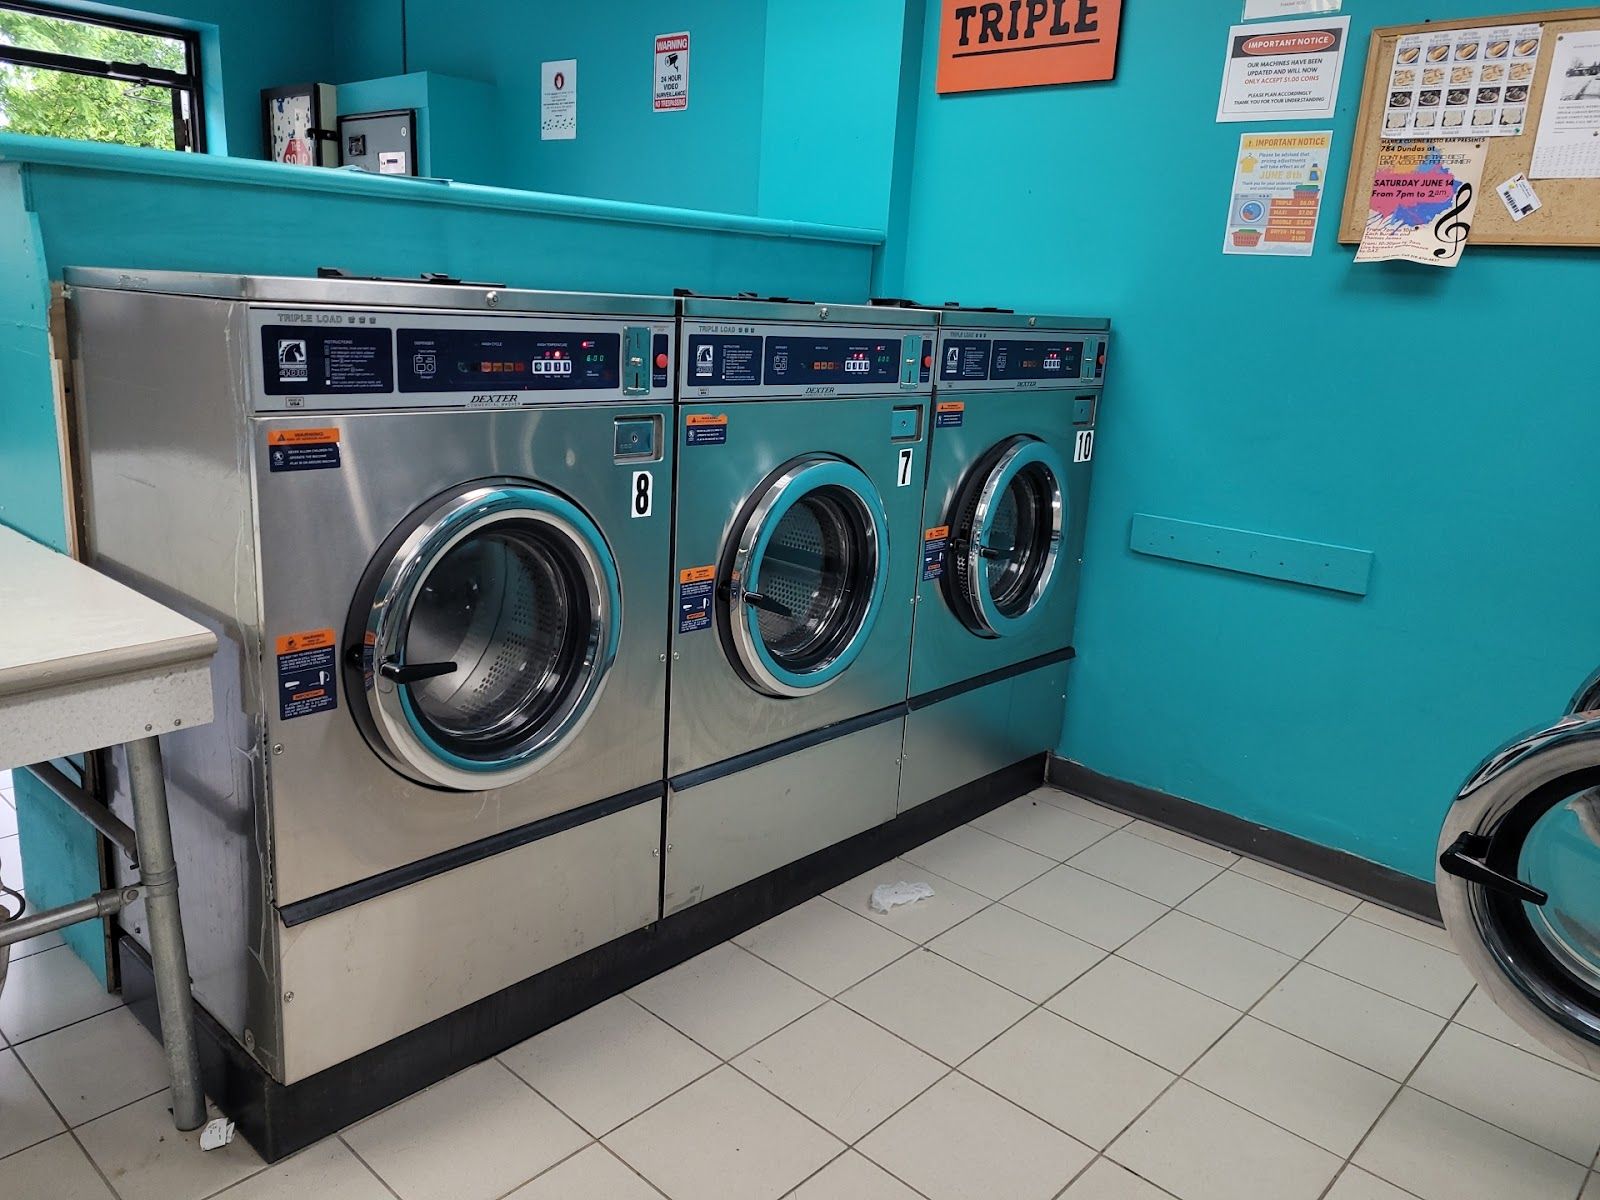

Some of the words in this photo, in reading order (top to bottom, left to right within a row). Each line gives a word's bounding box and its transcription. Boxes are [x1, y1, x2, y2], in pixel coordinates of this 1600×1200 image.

[955, 0, 1099, 46] TRIPLE
[656, 38, 687, 51] WARNING
[1248, 38, 1296, 49] IMPORTANT
[1297, 36, 1329, 46] NOTICE
[667, 74, 682, 82] HOUR
[663, 83, 679, 91] VIDEO
[656, 90, 686, 98] SURVEILLANCE
[1255, 138, 1297, 147] IMPORTANT
[1298, 137, 1325, 146] NOTICE
[1373, 179, 1420, 187] SATURDAY
[1420, 179, 1444, 187] JUNE
[1445, 179, 1454, 187] 14
[1396, 190, 1414, 199] 7pm
[277, 313, 313, 323] TRIPLE
[316, 314, 343, 324] LOAD
[804, 386, 835, 394] DEXTER
[469, 394, 518, 403] DEXTER
[1077, 431, 1092, 461] 10
[901, 450, 911, 485] 7
[635, 473, 649, 515] 8
